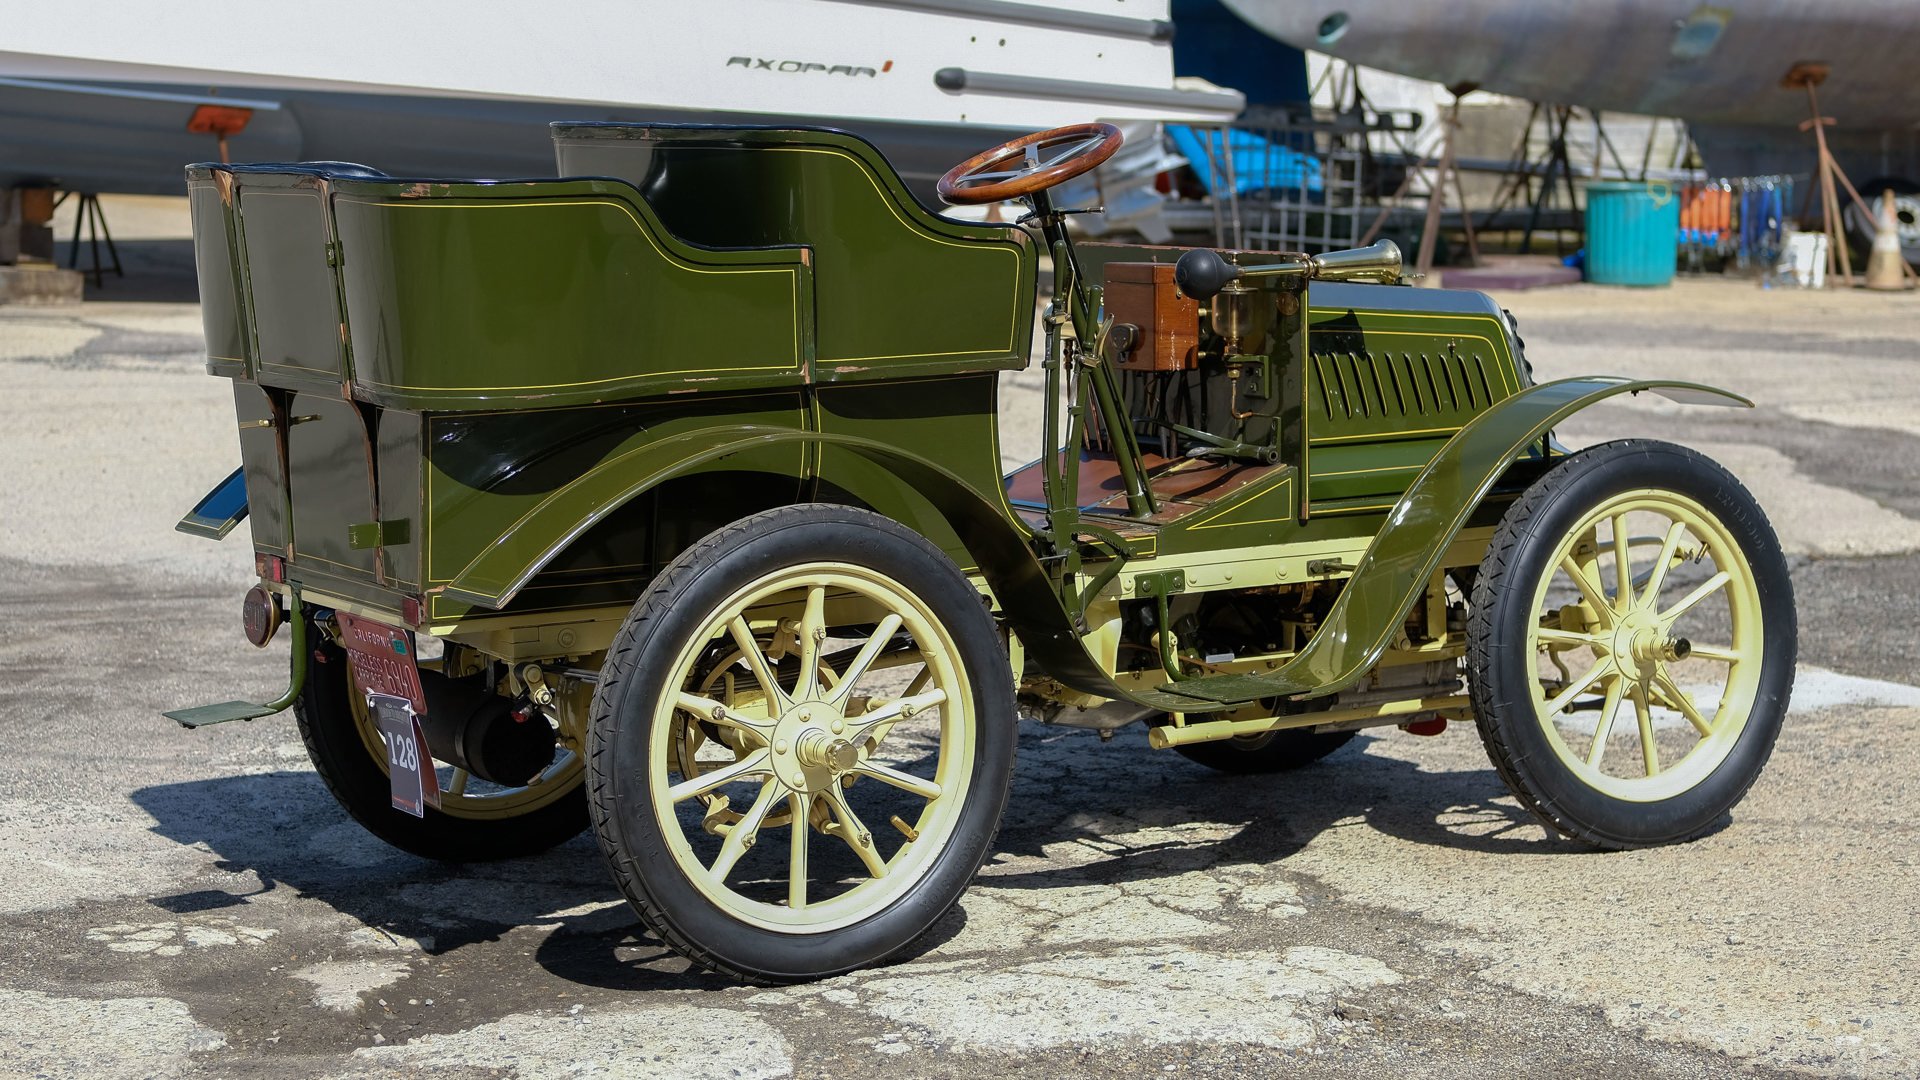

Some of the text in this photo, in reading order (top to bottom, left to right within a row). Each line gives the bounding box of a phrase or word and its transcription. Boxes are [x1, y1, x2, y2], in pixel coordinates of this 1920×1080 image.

[726, 56, 877, 78] AXOPAR
[353, 627, 391, 647] CALIFORNIA
[347, 648, 383, 673] HORSELESS
[384, 659, 417, 701] 6940
[387, 731, 417, 771] 128
